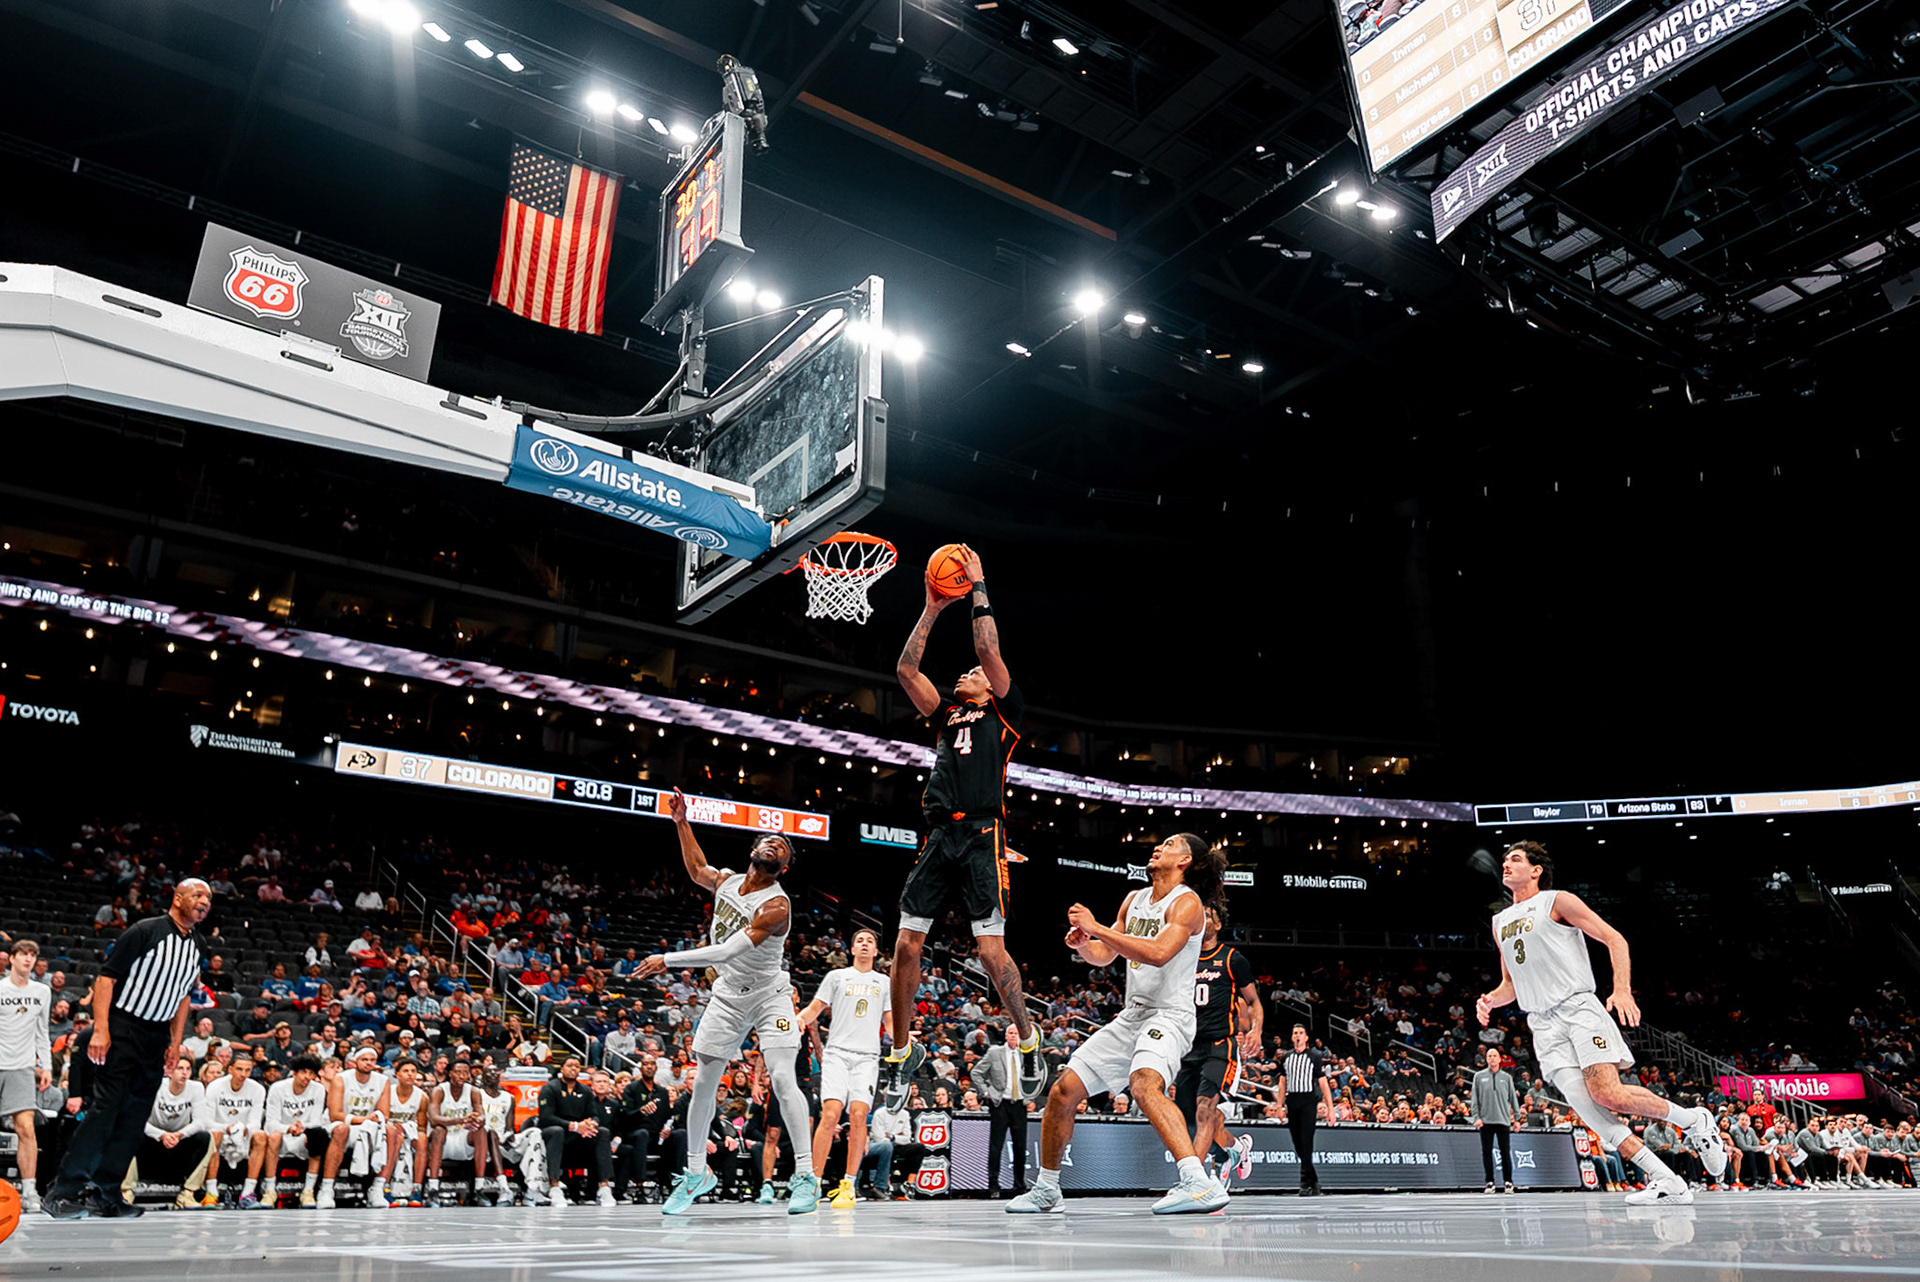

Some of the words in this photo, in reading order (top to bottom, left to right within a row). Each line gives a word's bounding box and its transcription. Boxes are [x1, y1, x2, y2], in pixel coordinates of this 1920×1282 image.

[1483, 27, 1492, 42] 0
[1509, 6, 1588, 70] COLORADO
[1392, 32, 1427, 63] Inman
[1547, 68, 1636, 139] T-SHIRTS
[1642, 36, 1687, 79] AND
[1693, 0, 1758, 44] CAPS
[1525, 67, 1604, 133] OFFICIAL
[1374, 144, 1391, 162] 24
[1492, 68, 1502, 83] 0
[242, 255, 297, 283] PHILLIPS
[239, 275, 289, 306] 66
[579, 459, 684, 508] Allstate
[552, 485, 680, 529] Allstate
[33, 588, 58, 604] AND
[60, 594, 91, 610] CAPS
[92, 599, 108, 613] OF
[109, 602, 131, 618] THE
[132, 608, 153, 622] BIG
[155, 612, 170, 625] 12
[9, 702, 80, 726] TOYOTA
[953, 727, 972, 755] 4
[401, 755, 433, 780] 37
[447, 764, 550, 794] COLORADO
[573, 780, 613, 801] 30.8
[636, 794, 655, 807] 1ST
[1140, 790, 1158, 801] CAPS
[1168, 792, 1180, 802] THE
[1193, 794, 1202, 803] 12
[1533, 806, 1561, 818] Baylor
[1618, 804, 1650, 814] Arizona
[1651, 802, 1676, 812] State
[1779, 797, 1808, 807] Inman
[757, 809, 784, 830] 39
[860, 823, 918, 845] UMB
[1294, 875, 1328, 888] Mobile
[1329, 879, 1364, 890] CENTER
[714, 898, 751, 930] BUFFS
[1501, 917, 1534, 942] BUFFS
[1514, 938, 1526, 965] 3
[845, 984, 880, 998] BUFFS
[1196, 984, 1209, 1006] 0
[855, 999, 868, 1018] 0
[1769, 1078, 1830, 1097] Mobile
[921, 1127, 944, 1142] 66
[1266, 1152, 1297, 1164] LOCKER
[1321, 1152, 1353, 1164] T-SHIRTS
[1355, 1153, 1371, 1164] AND
[1371, 1153, 1391, 1164] CAPS
[1391, 1153, 1401, 1164] OF
[1400, 1154, 1416, 1165] THE
[1415, 1154, 1428, 1165] BIG
[1429, 1154, 1439, 1165] 12
[920, 1172, 943, 1187] 66
